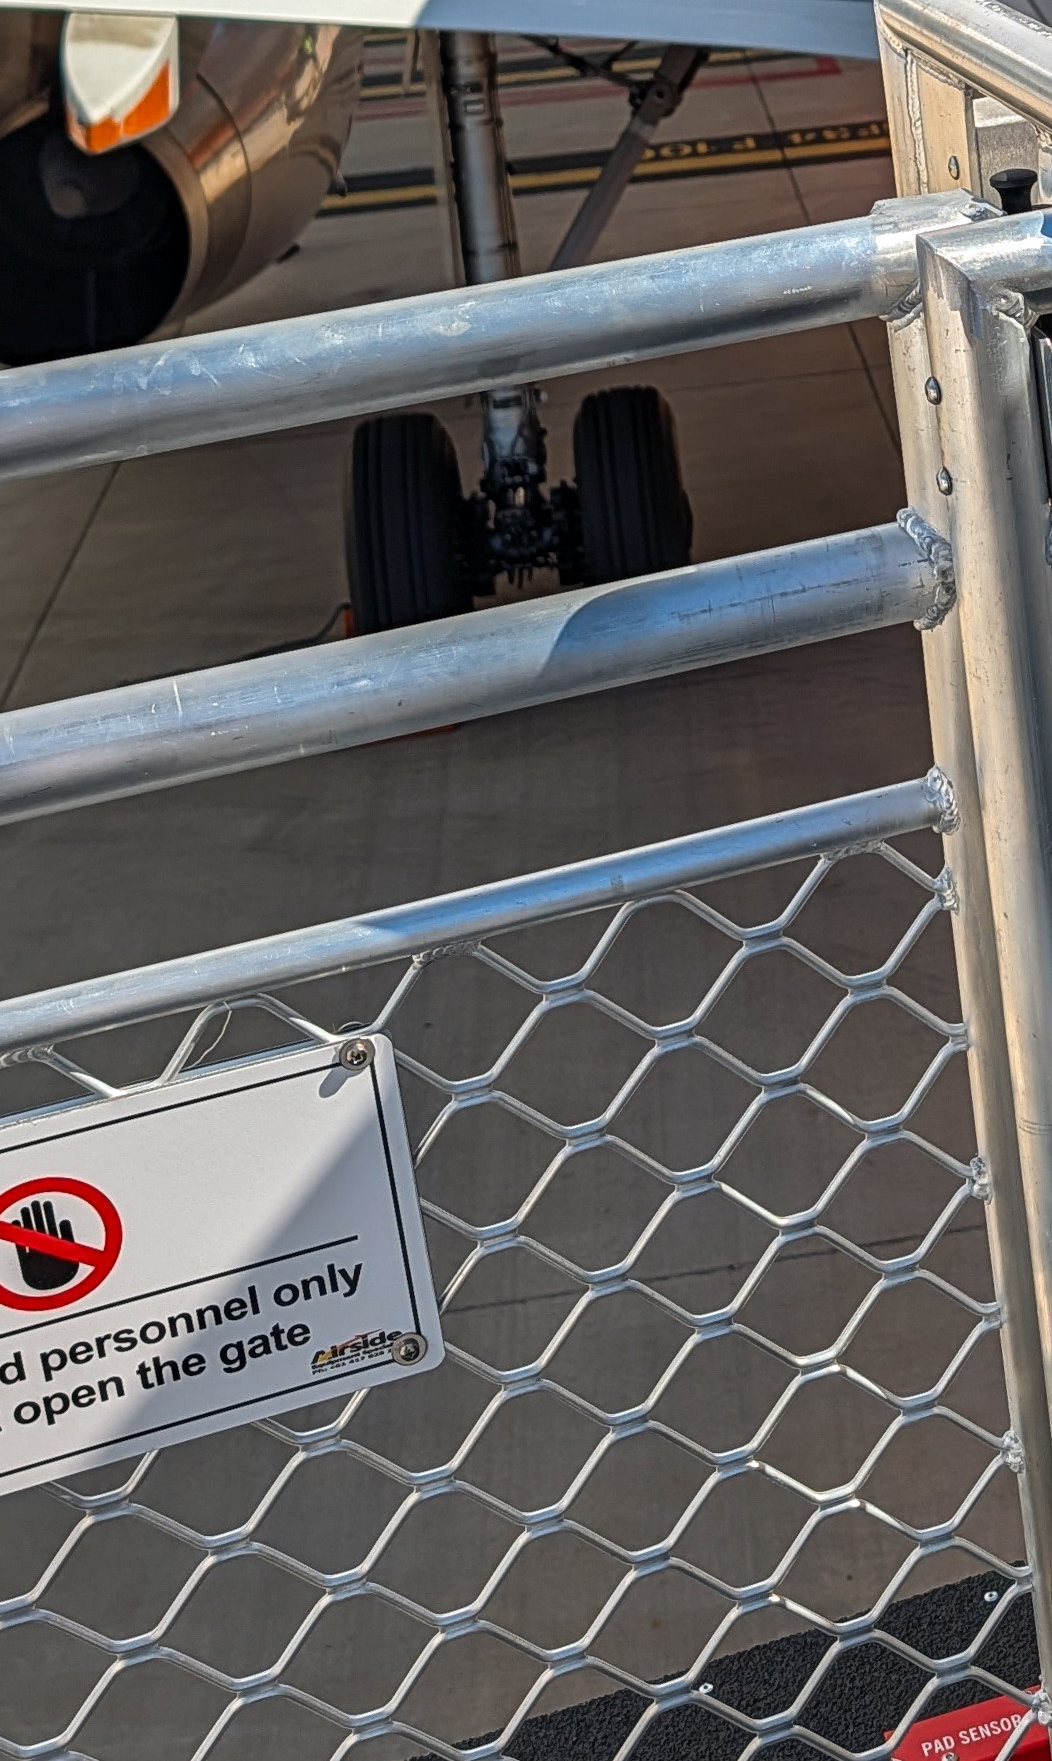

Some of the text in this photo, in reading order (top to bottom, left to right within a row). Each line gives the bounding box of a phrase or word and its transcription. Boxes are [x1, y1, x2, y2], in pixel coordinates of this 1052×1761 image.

[13, 1322, 311, 1426] open the gate
[40, 1285, 260, 1382] personnel
[273, 1263, 363, 1307] only
[921, 1714, 1022, 1757] PAD SENSOR
